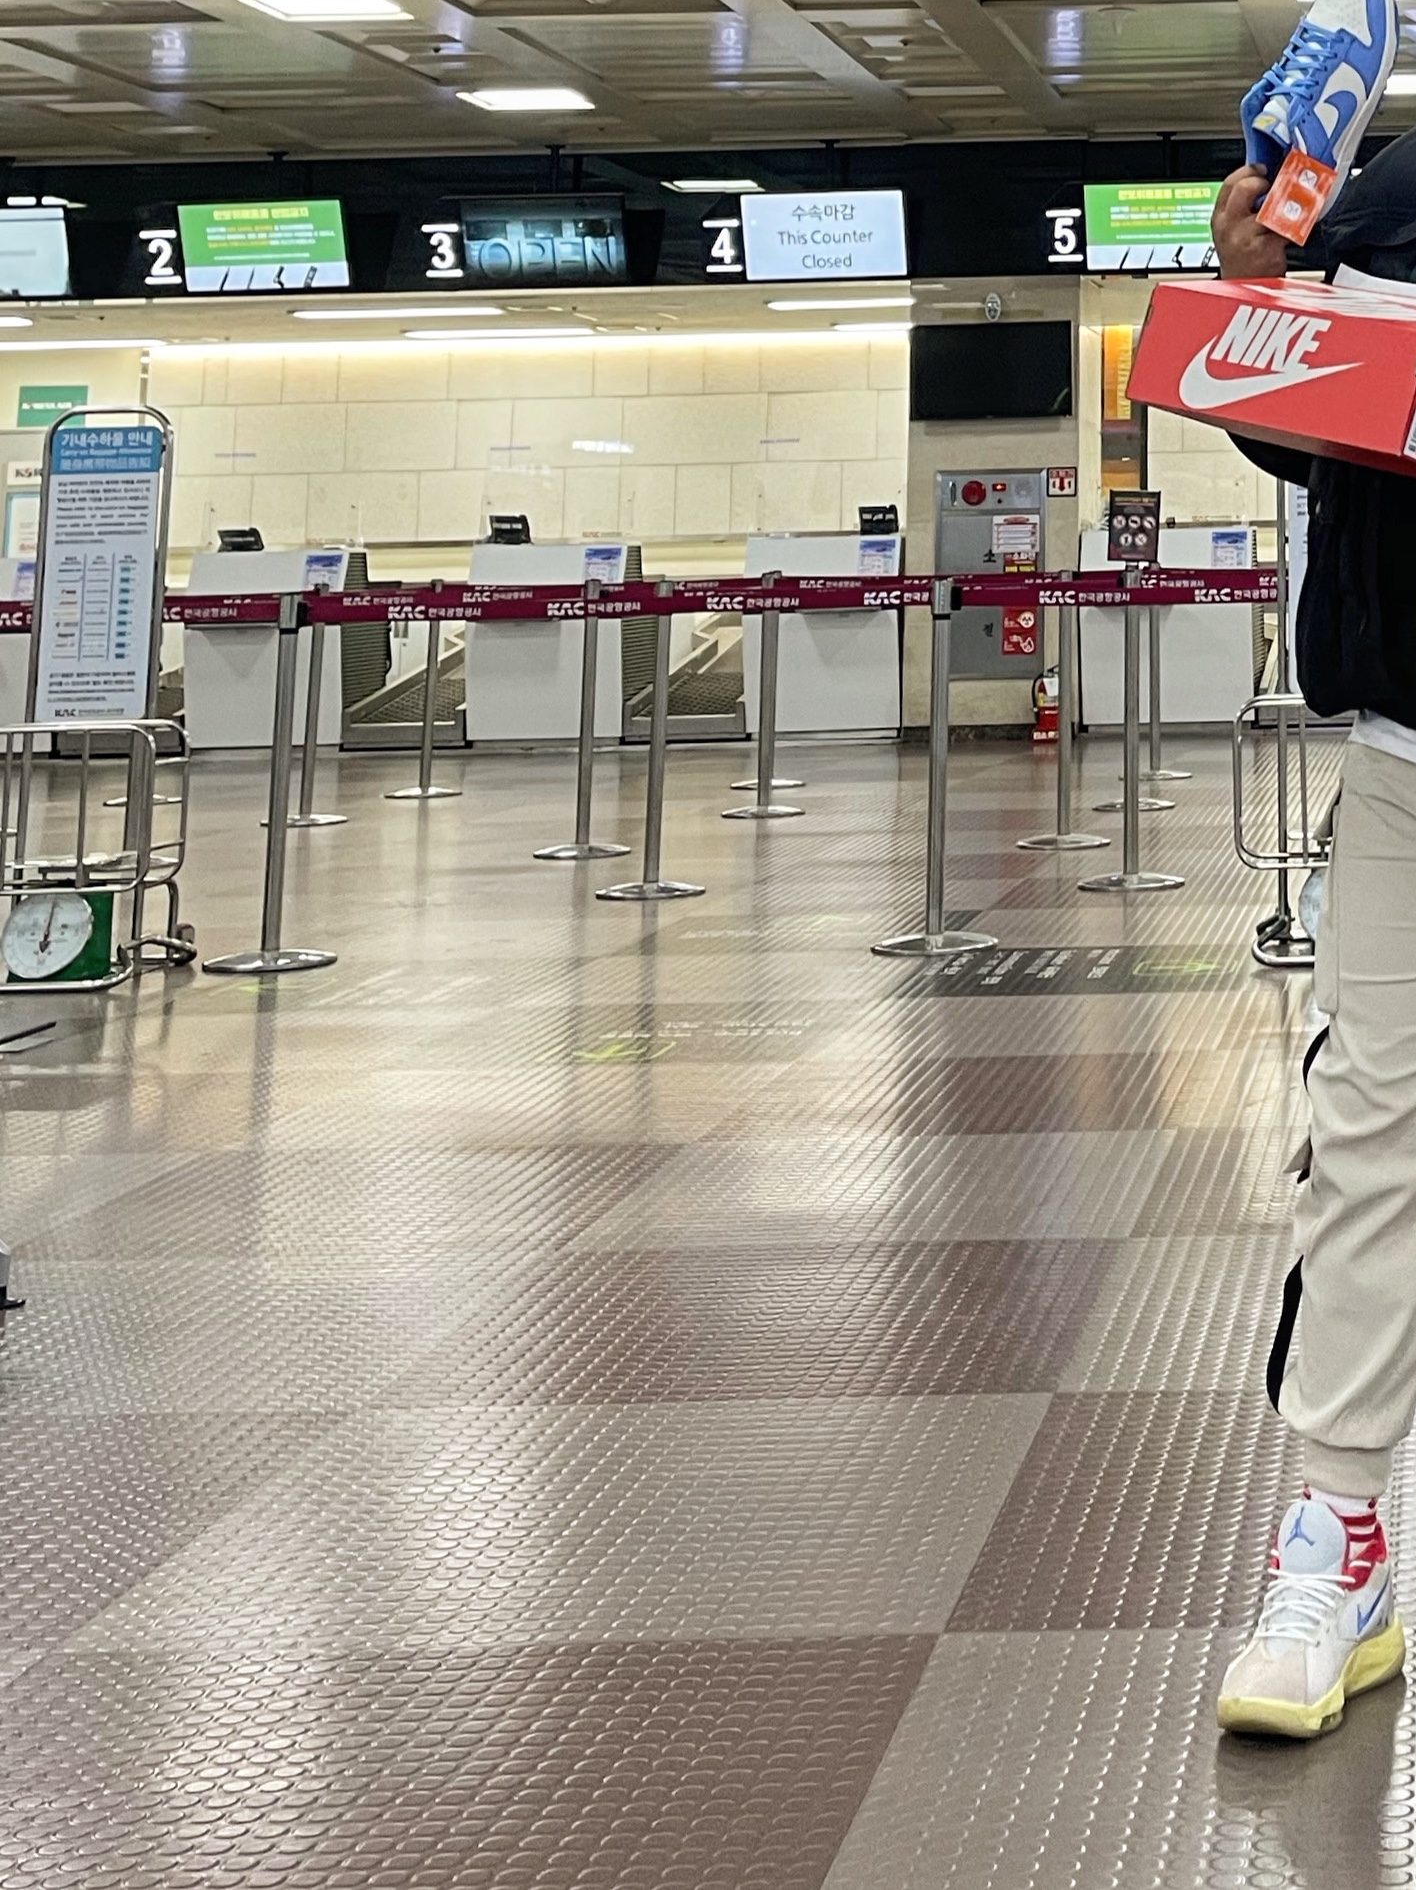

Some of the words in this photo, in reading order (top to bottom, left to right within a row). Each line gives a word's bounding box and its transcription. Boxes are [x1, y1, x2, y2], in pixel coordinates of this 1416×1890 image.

[791, 203, 855, 222] 수속마감
[777, 230, 807, 246] This
[810, 228, 873, 245] Counter
[1054, 217, 1077, 254] 5
[430, 232, 455, 270] 3
[711, 227, 735, 265] 4
[147, 237, 175, 277] 2
[479, 236, 619, 280] OPEN
[801, 252, 853, 270] Closed
[1211, 304, 1334, 373] NIKE
[128, 431, 154, 446] 안내
[462, 591, 490, 603] KAC
[706, 596, 744, 610] KAC
[746, 596, 800, 609] 한국공항공사
[863, 591, 901, 606] KAC
[1039, 590, 1076, 604] KAC
[1078, 591, 1131, 603] 한국공항공사
[1194, 588, 1232, 603] KAC
[388, 605, 426, 619] KAC
[428, 607, 481, 618] 한국공항공사
[547, 602, 585, 617] KAC
[588, 601, 641, 613] 한국공항공사
